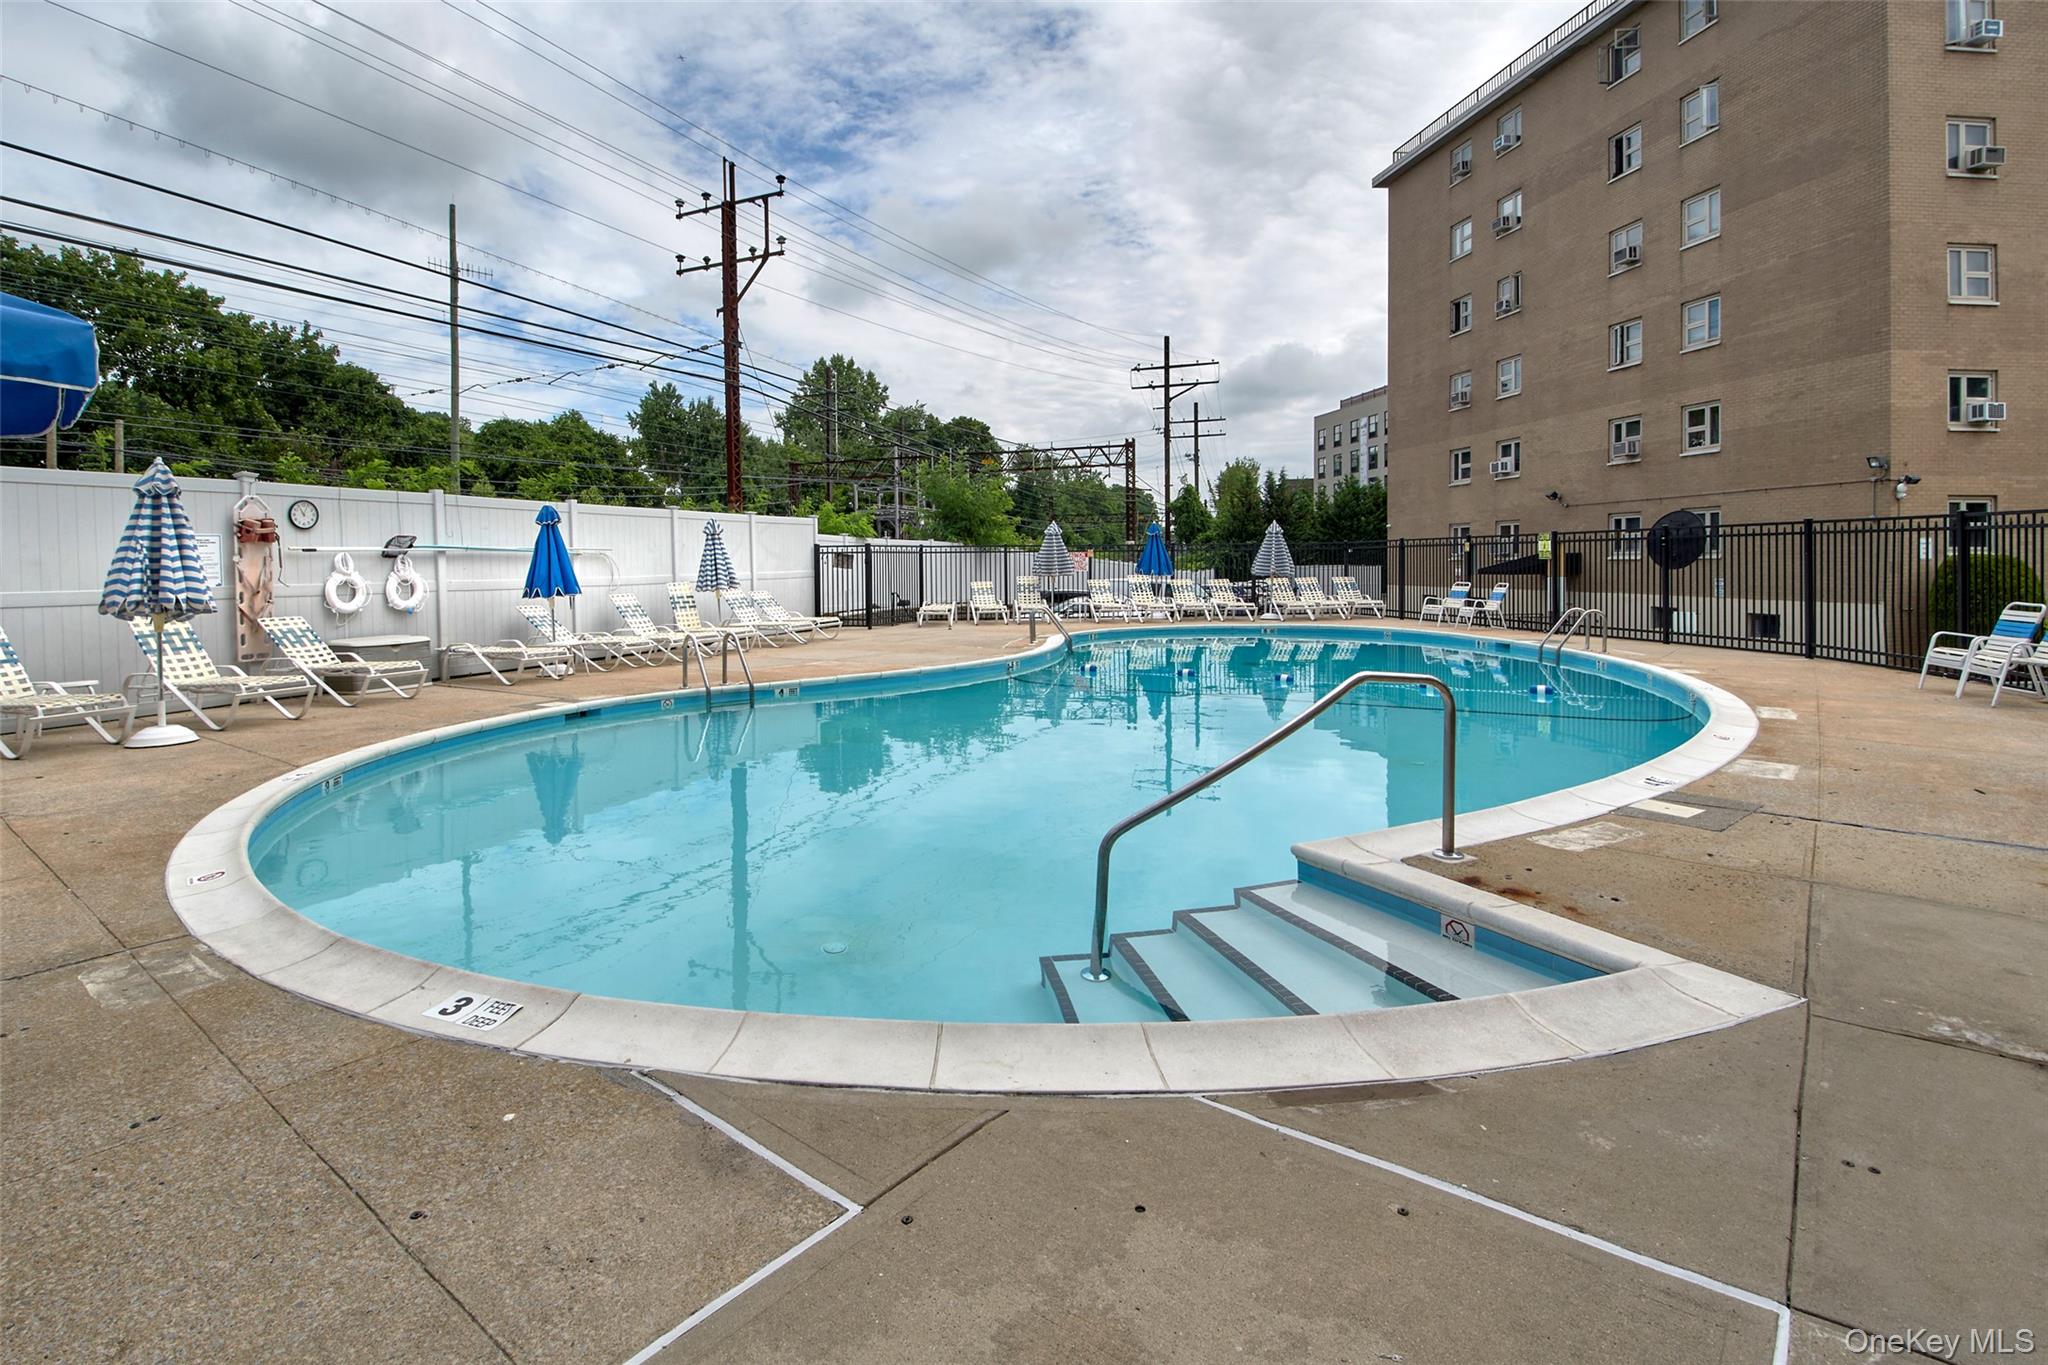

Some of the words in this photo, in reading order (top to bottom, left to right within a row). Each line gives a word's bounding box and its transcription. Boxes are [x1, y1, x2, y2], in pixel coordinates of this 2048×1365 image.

[438, 997, 474, 1016] 3
[483, 1000, 517, 1016] FEET
[462, 1015, 497, 1028] DEEP
